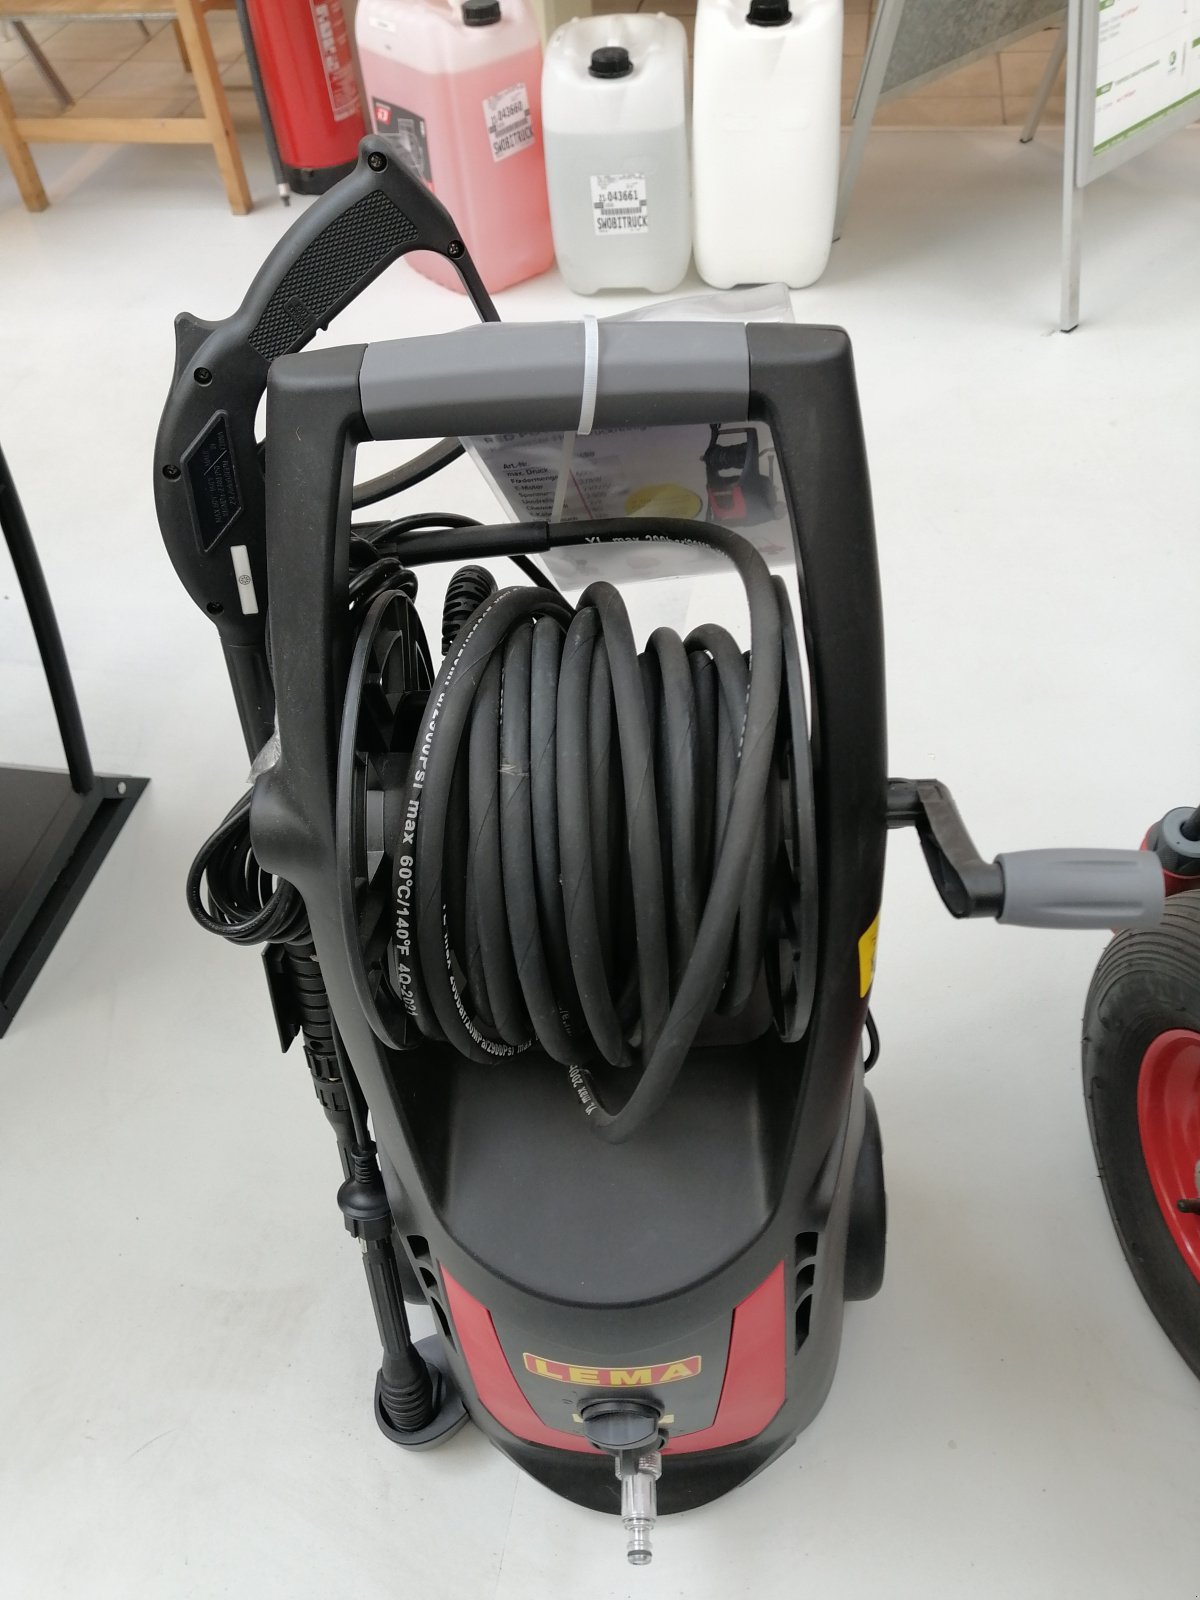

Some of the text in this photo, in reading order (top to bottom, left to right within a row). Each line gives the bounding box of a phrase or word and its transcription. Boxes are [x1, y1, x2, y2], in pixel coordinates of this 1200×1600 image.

[607, 190, 638, 202] 043661
[596, 215, 649, 230] SWOBITRUCK
[402, 799, 421, 845] max
[395, 854, 415, 957] 60°C/140°F
[577, 1085, 592, 1104] max
[535, 1359, 693, 1385] LEMA
